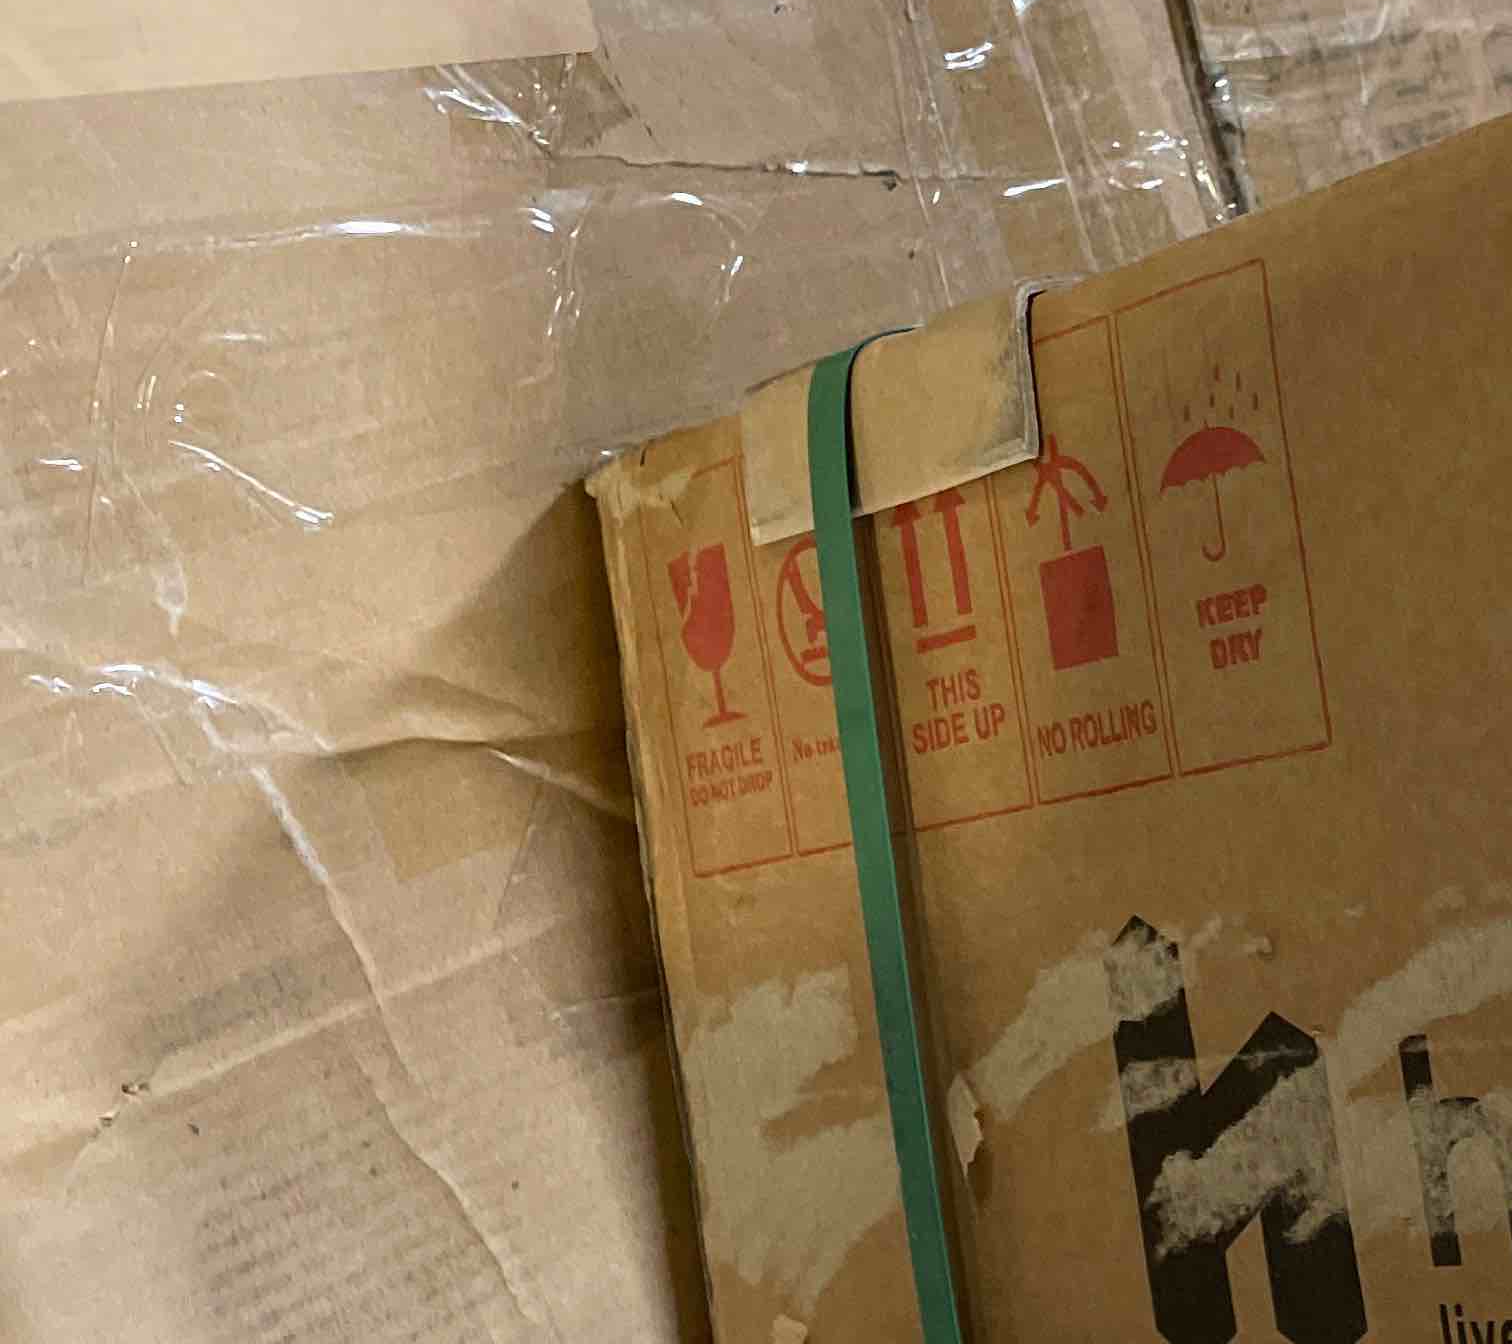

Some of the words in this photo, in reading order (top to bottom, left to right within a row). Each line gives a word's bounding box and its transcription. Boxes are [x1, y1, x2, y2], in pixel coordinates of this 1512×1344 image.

[1196, 583, 1268, 627] KEEP
[1209, 628, 1263, 670] DRY
[926, 668, 982, 712] THIS
[911, 712, 970, 755] SIDE
[974, 702, 1007, 740] UP
[1037, 722, 1067, 758] NO
[1070, 698, 1159, 753] ROLLING
[685, 736, 764, 778] FRAGILE
